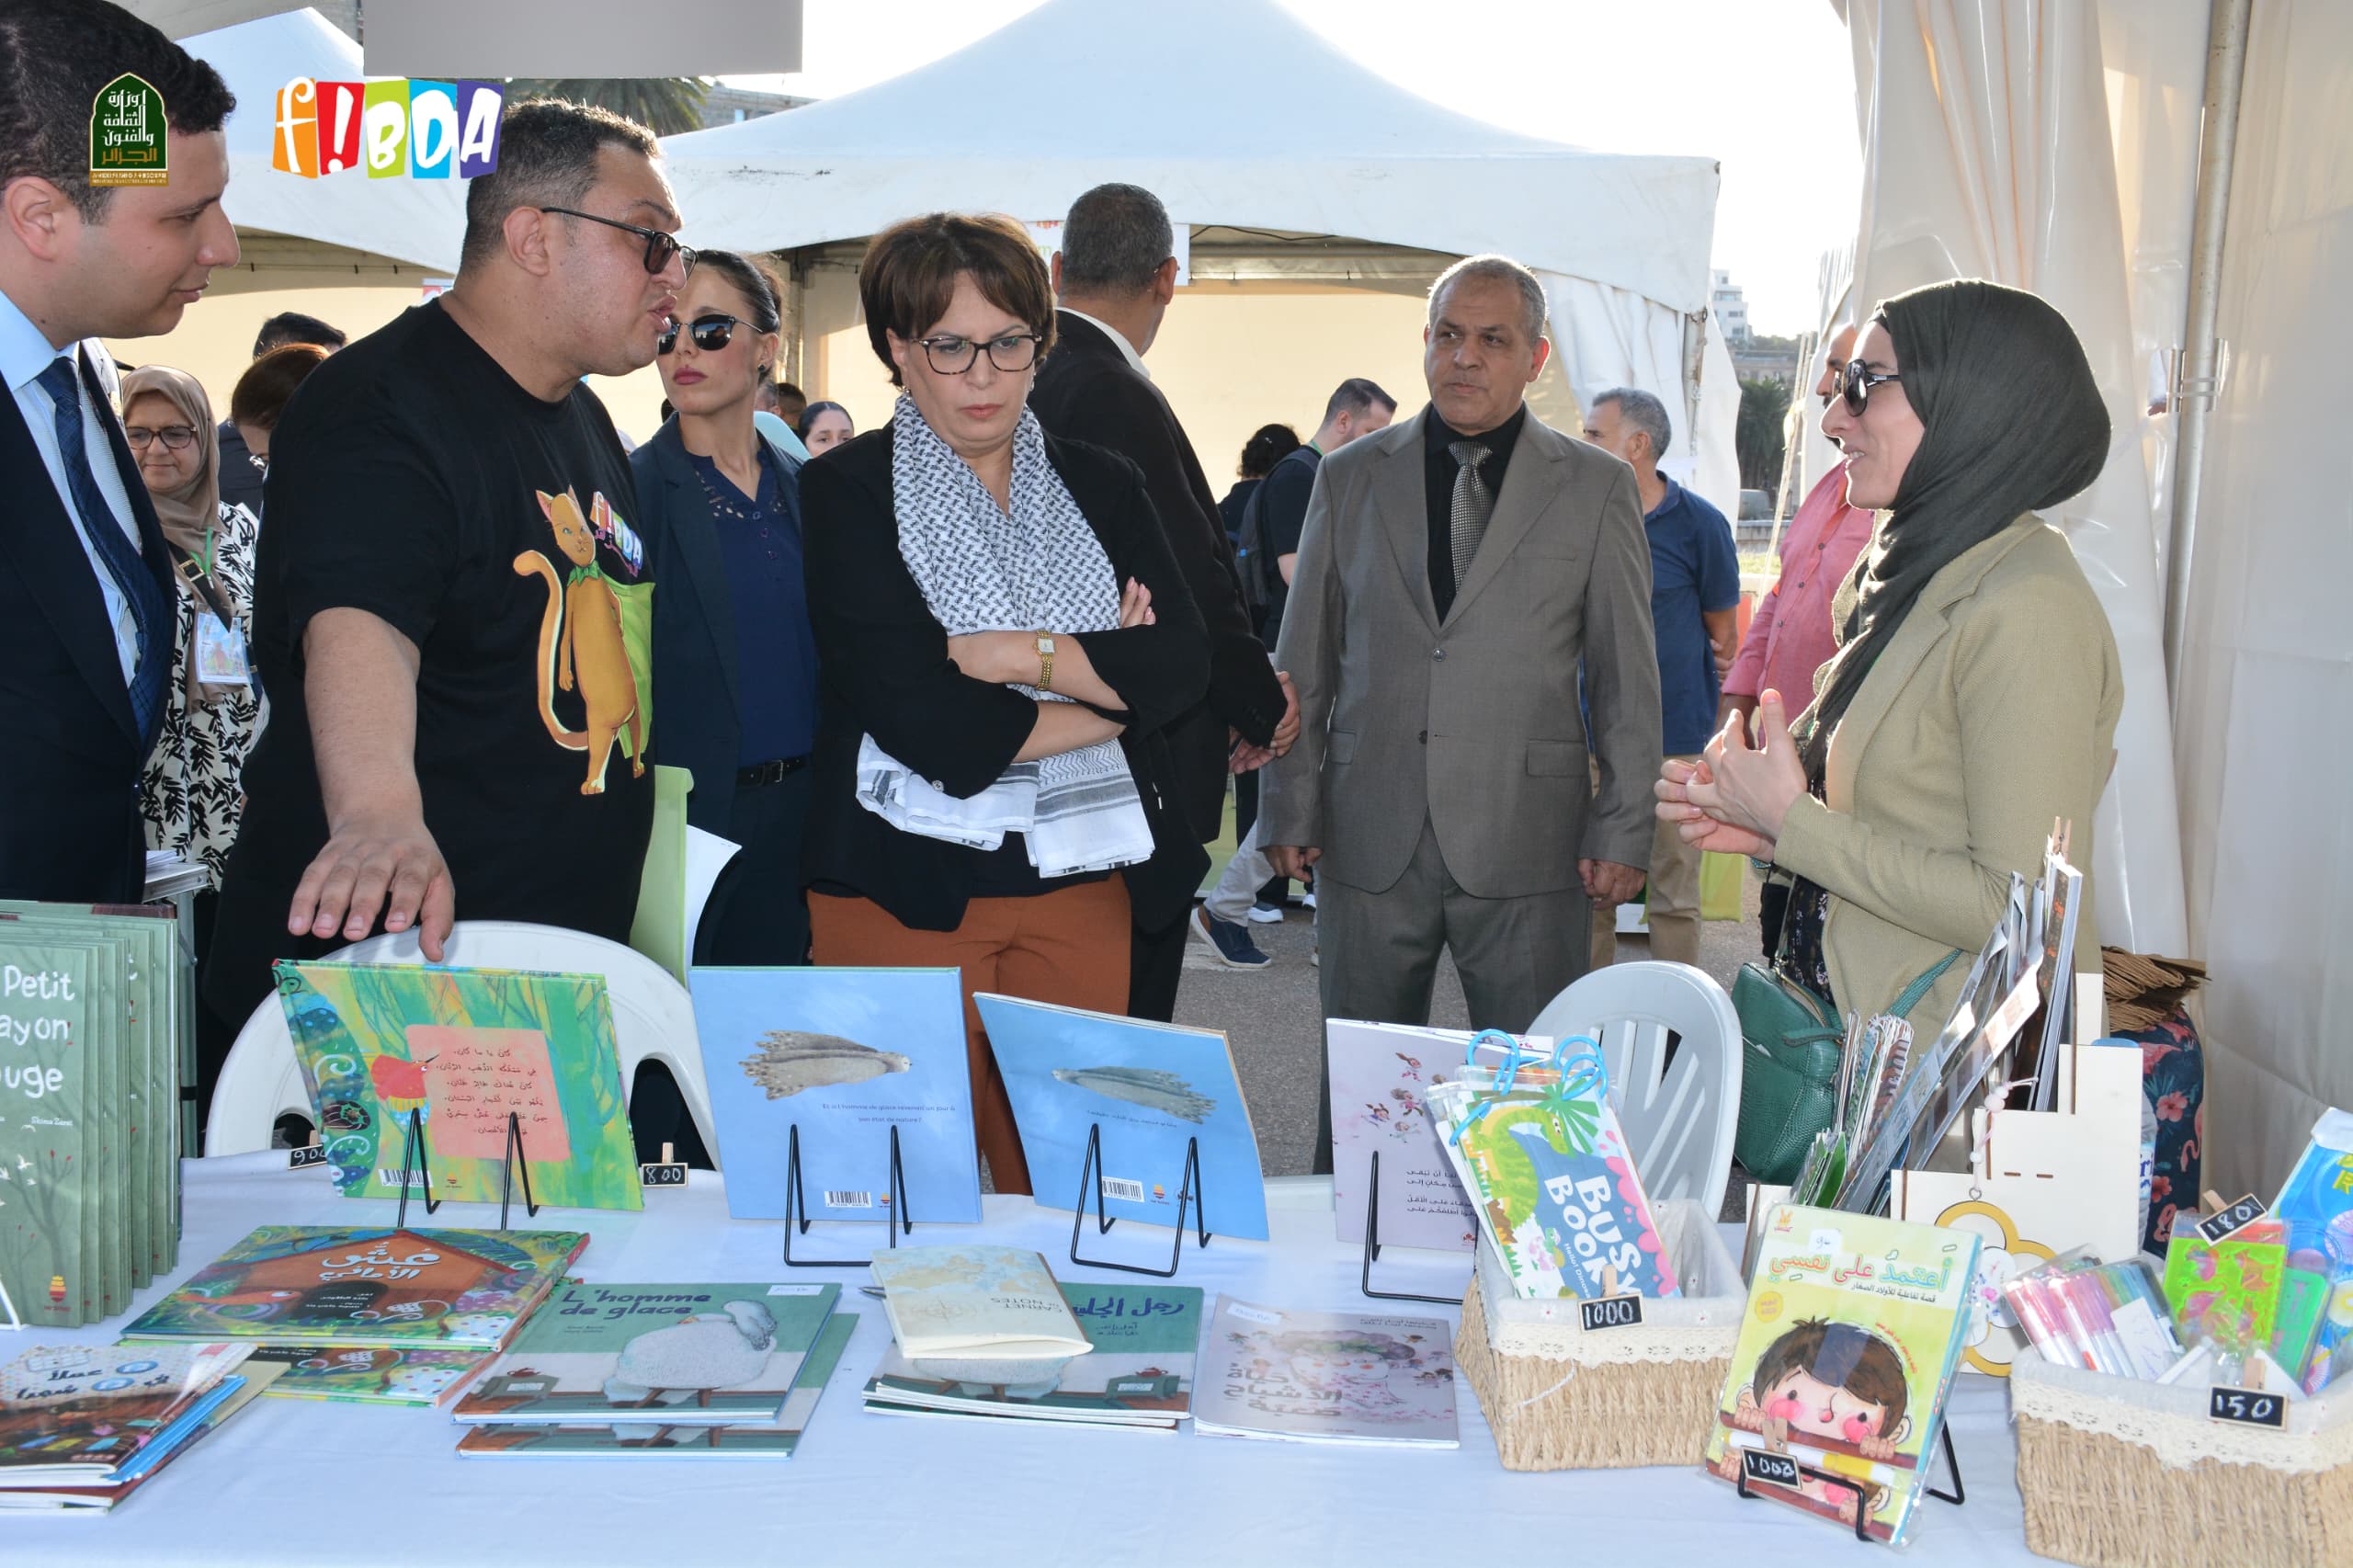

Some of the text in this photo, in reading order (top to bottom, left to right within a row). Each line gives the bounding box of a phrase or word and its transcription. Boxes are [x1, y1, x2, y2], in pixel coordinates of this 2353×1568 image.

[5, 964, 75, 1001] Petit
[0, 1064, 63, 1098] uge
[646, 1166, 682, 1184] 800
[1544, 1175, 1608, 1285] BOOK
[1575, 1175, 1643, 1294] BUSY
[560, 1301, 692, 1320] de glace
[1073, 1296, 1185, 1318] رجل الجلي
[1585, 1301, 1634, 1329] 1000
[2216, 1394, 2273, 1418] 150
